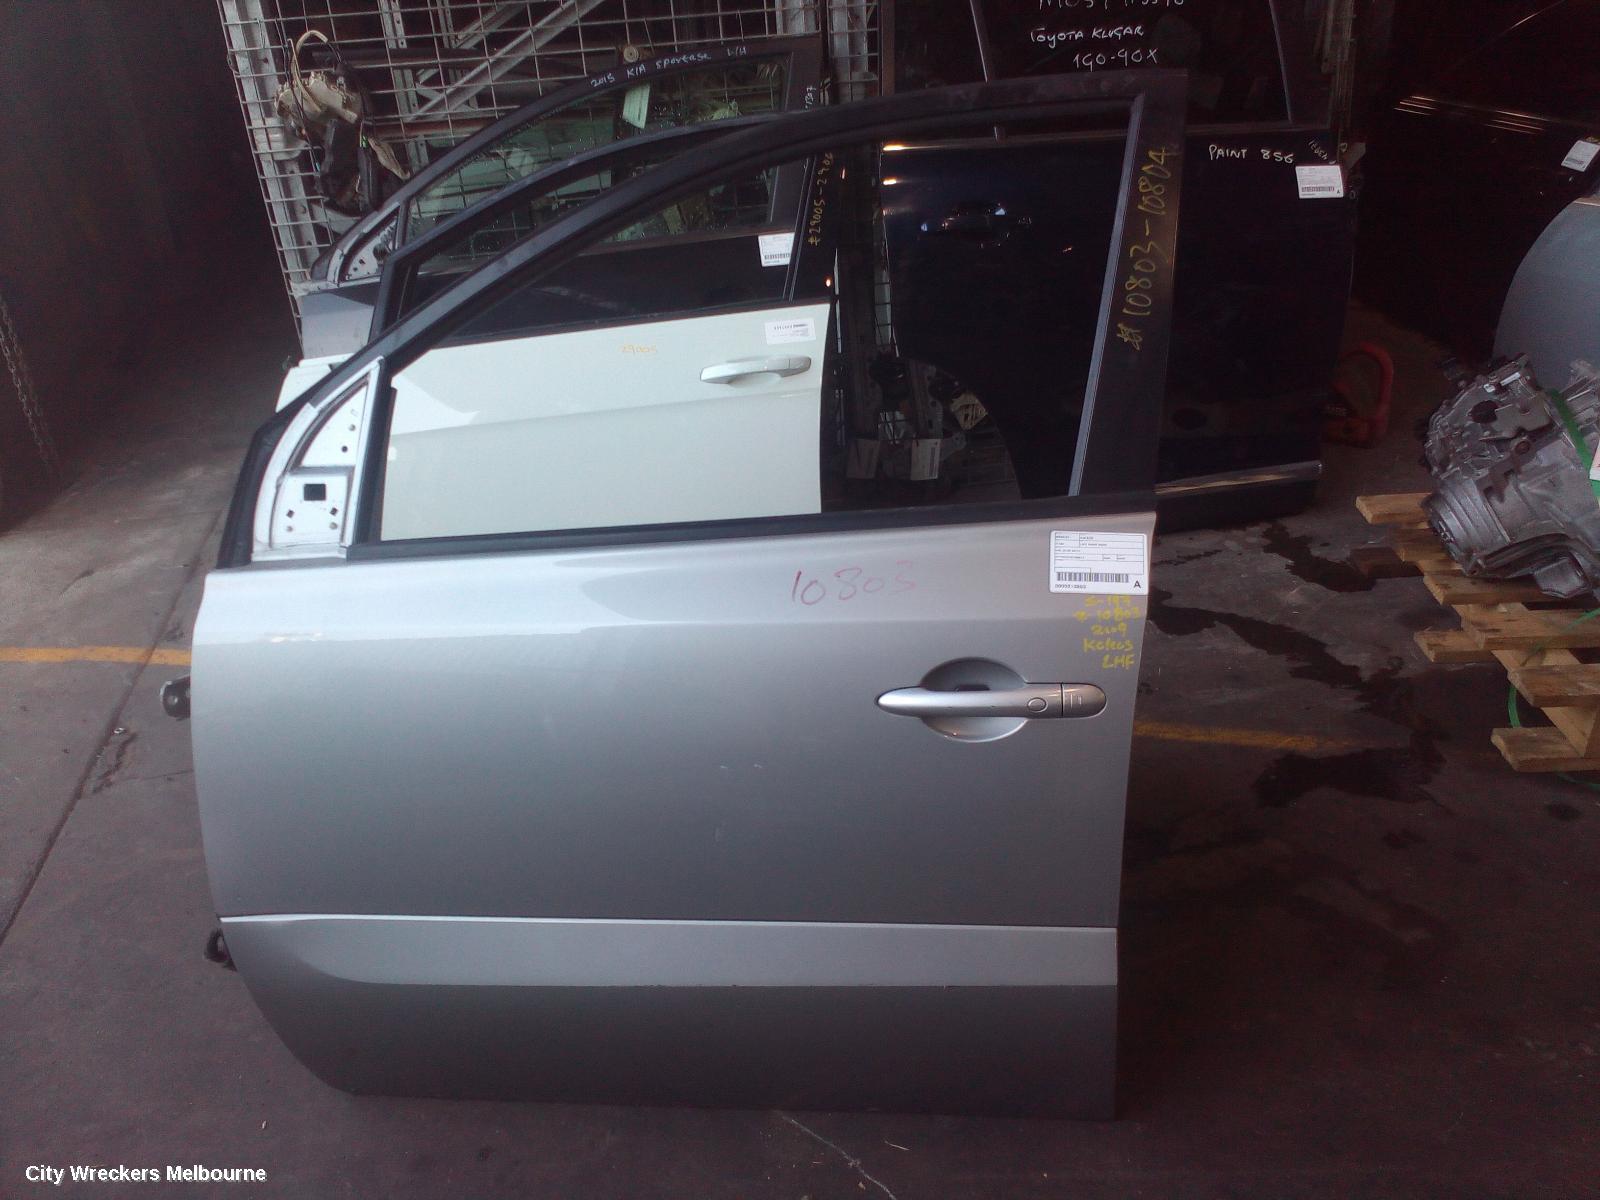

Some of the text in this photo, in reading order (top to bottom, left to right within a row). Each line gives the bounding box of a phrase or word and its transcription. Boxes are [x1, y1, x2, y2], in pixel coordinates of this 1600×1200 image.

[626, 64, 647, 79] KIA
[1208, 144, 1248, 161] PAINT
[1260, 149, 1294, 164] 856
[1133, 580, 1142, 588] A
